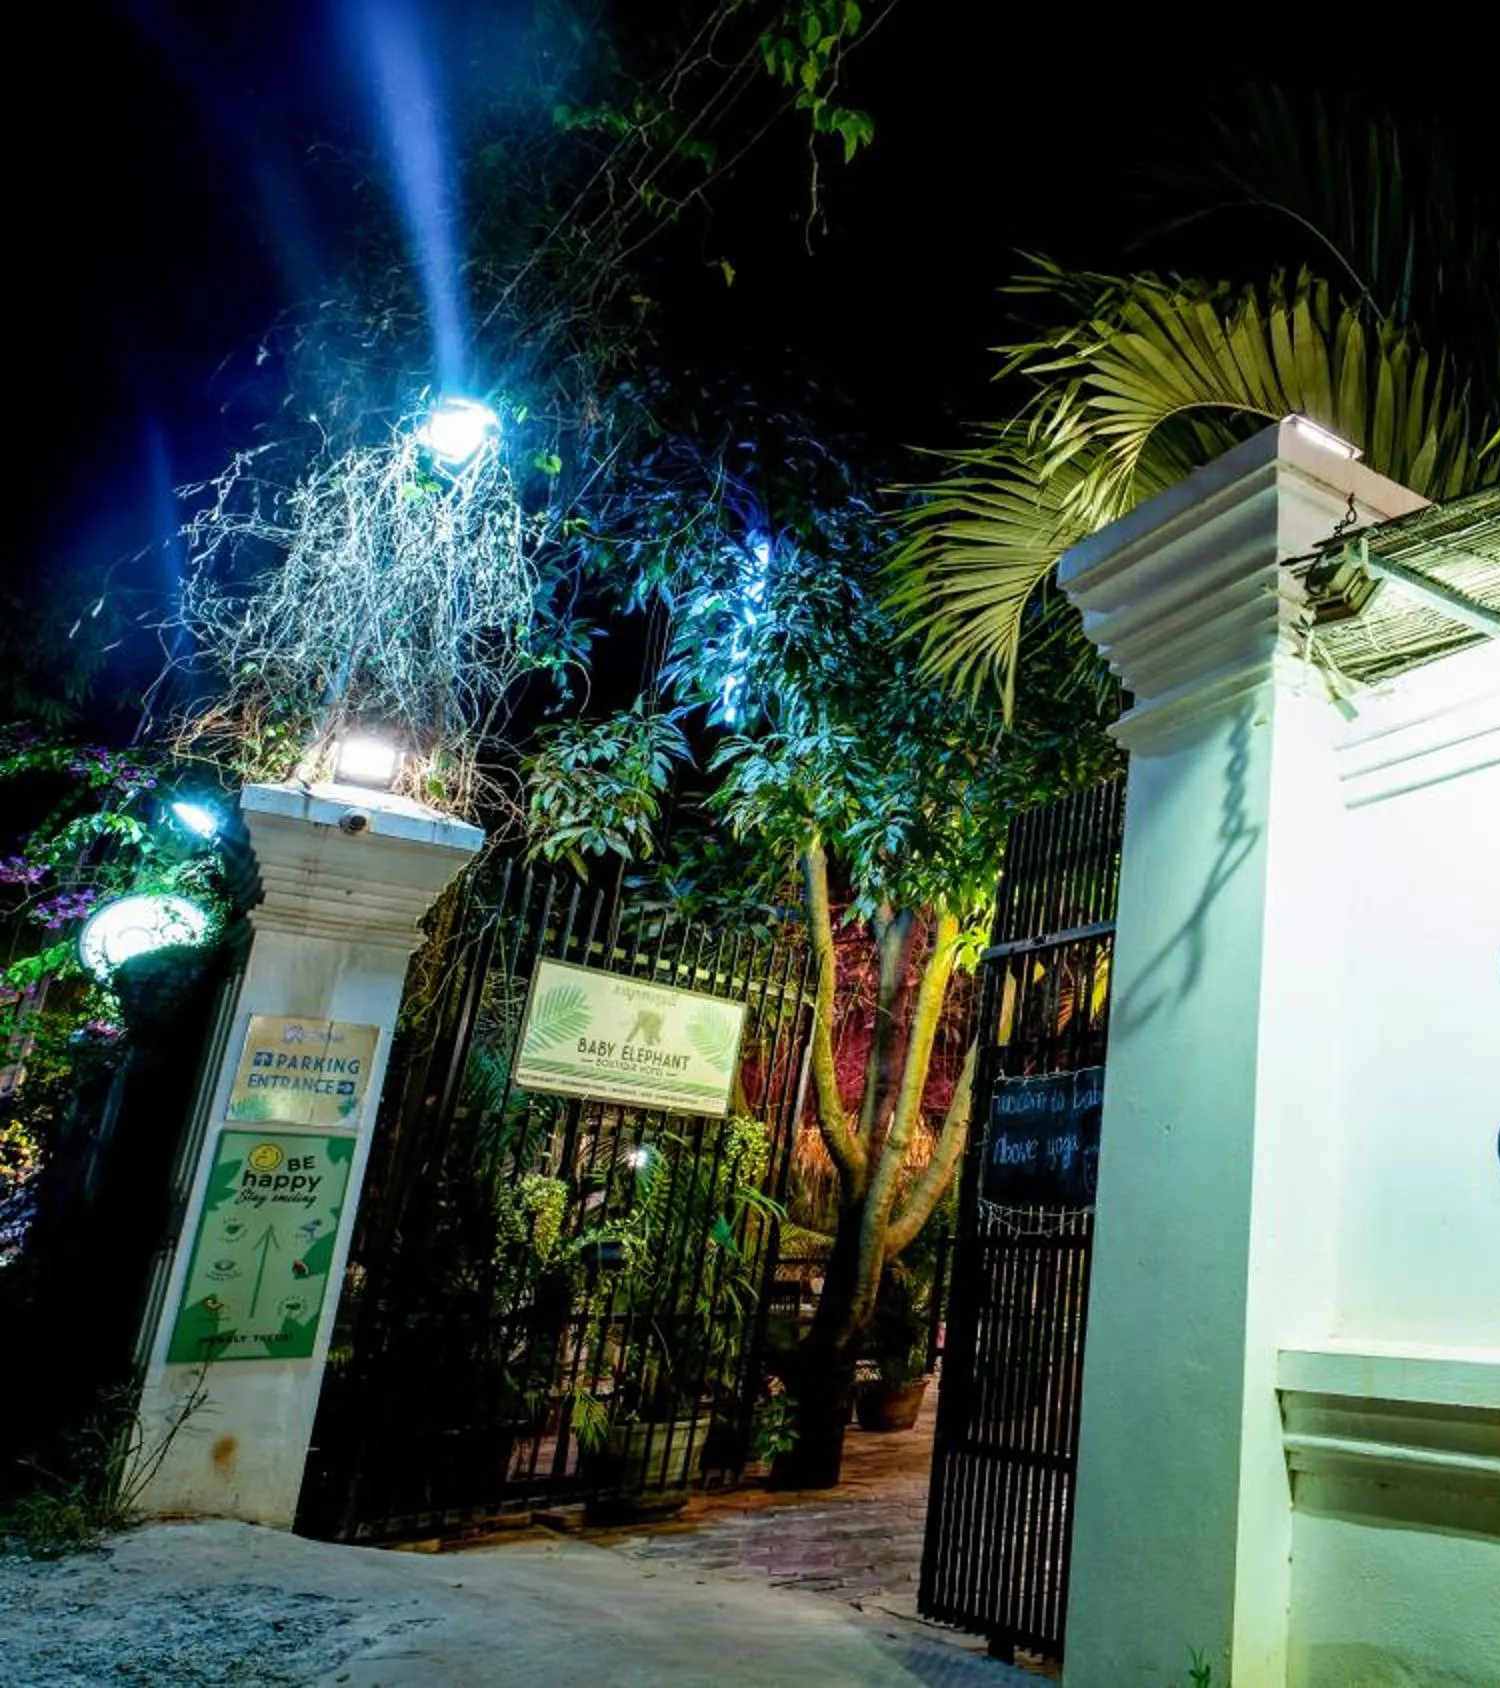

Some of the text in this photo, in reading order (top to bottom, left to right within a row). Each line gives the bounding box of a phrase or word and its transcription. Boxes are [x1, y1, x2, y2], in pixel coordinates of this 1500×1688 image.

[276, 1054, 361, 1074] PARKING
[577, 1038, 690, 1071] BABY ELEPHANT
[248, 1073, 335, 1095] ENTRANCE
[287, 1155, 316, 1172] BE
[242, 1169, 322, 1193] happy
